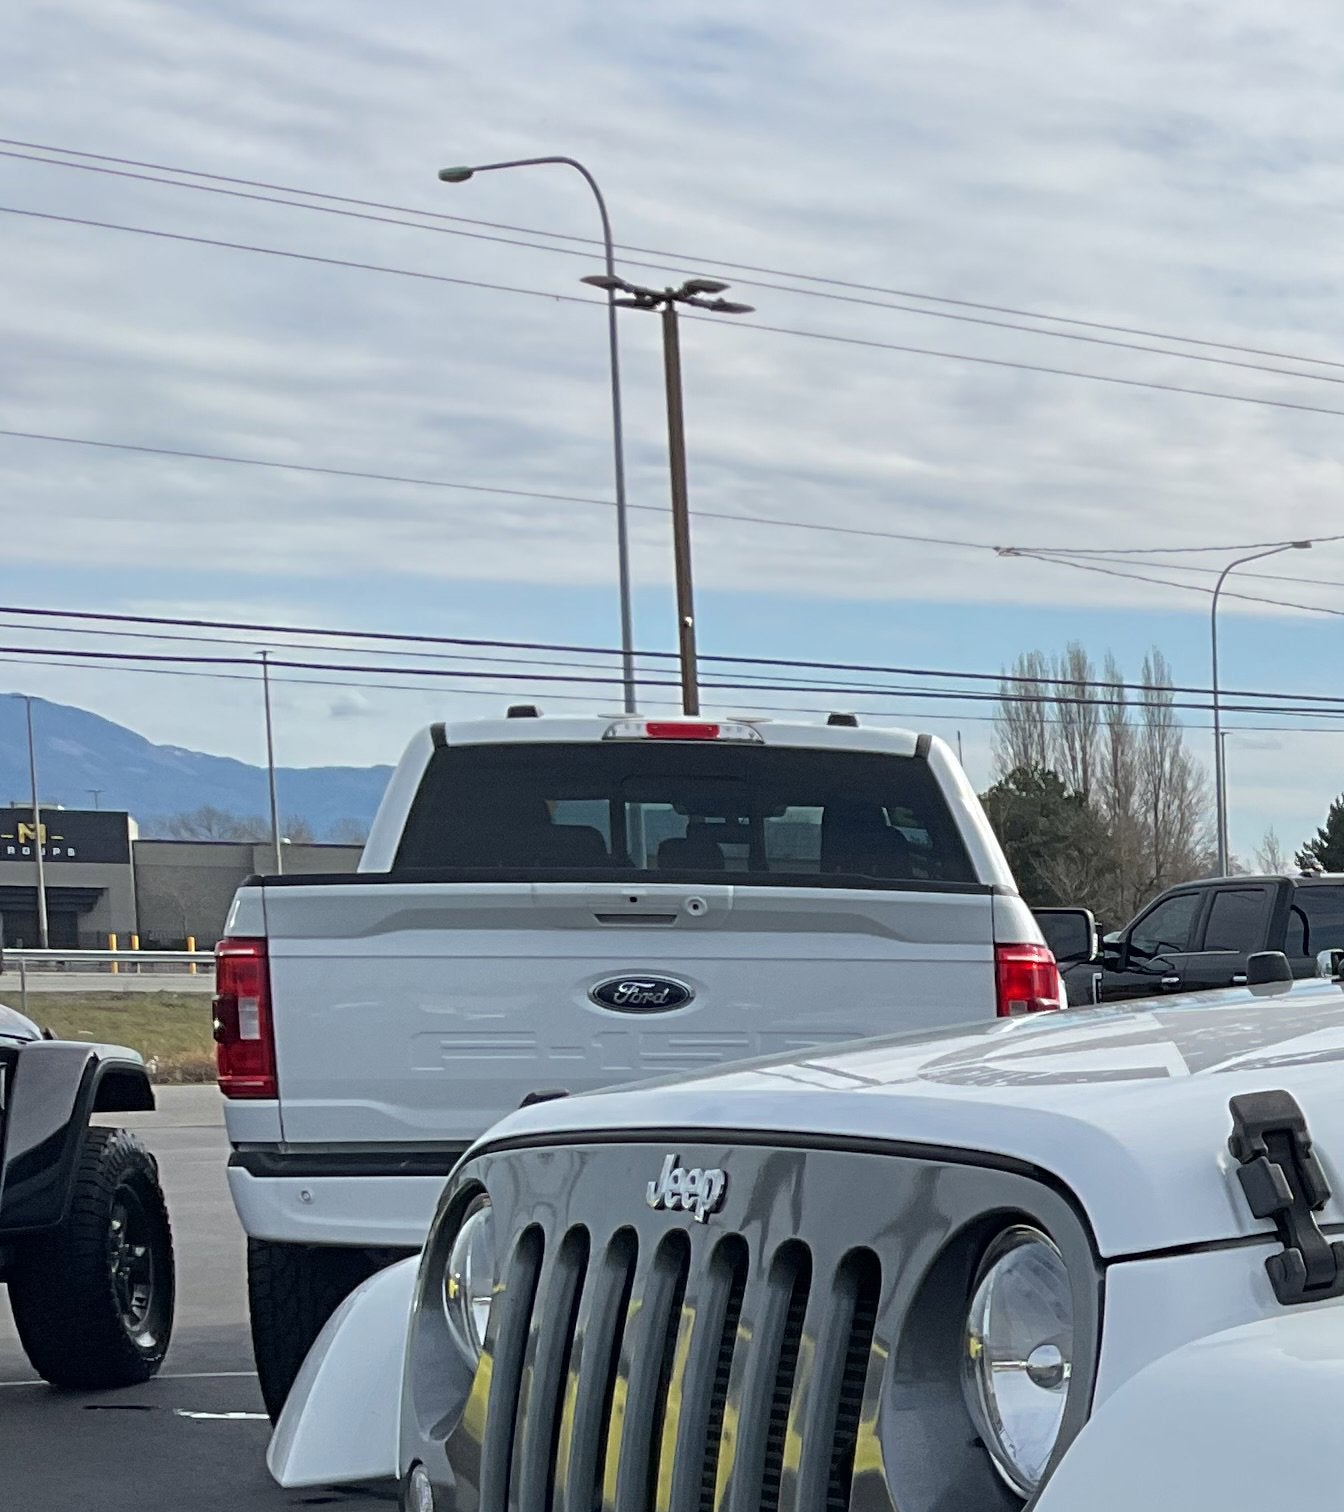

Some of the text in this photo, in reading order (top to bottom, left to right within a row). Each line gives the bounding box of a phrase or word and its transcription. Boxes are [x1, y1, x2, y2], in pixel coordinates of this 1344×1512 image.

[613, 980, 670, 1005] Ford
[409, 1029, 872, 1072] F-15
[646, 1153, 728, 1224] Jeep
